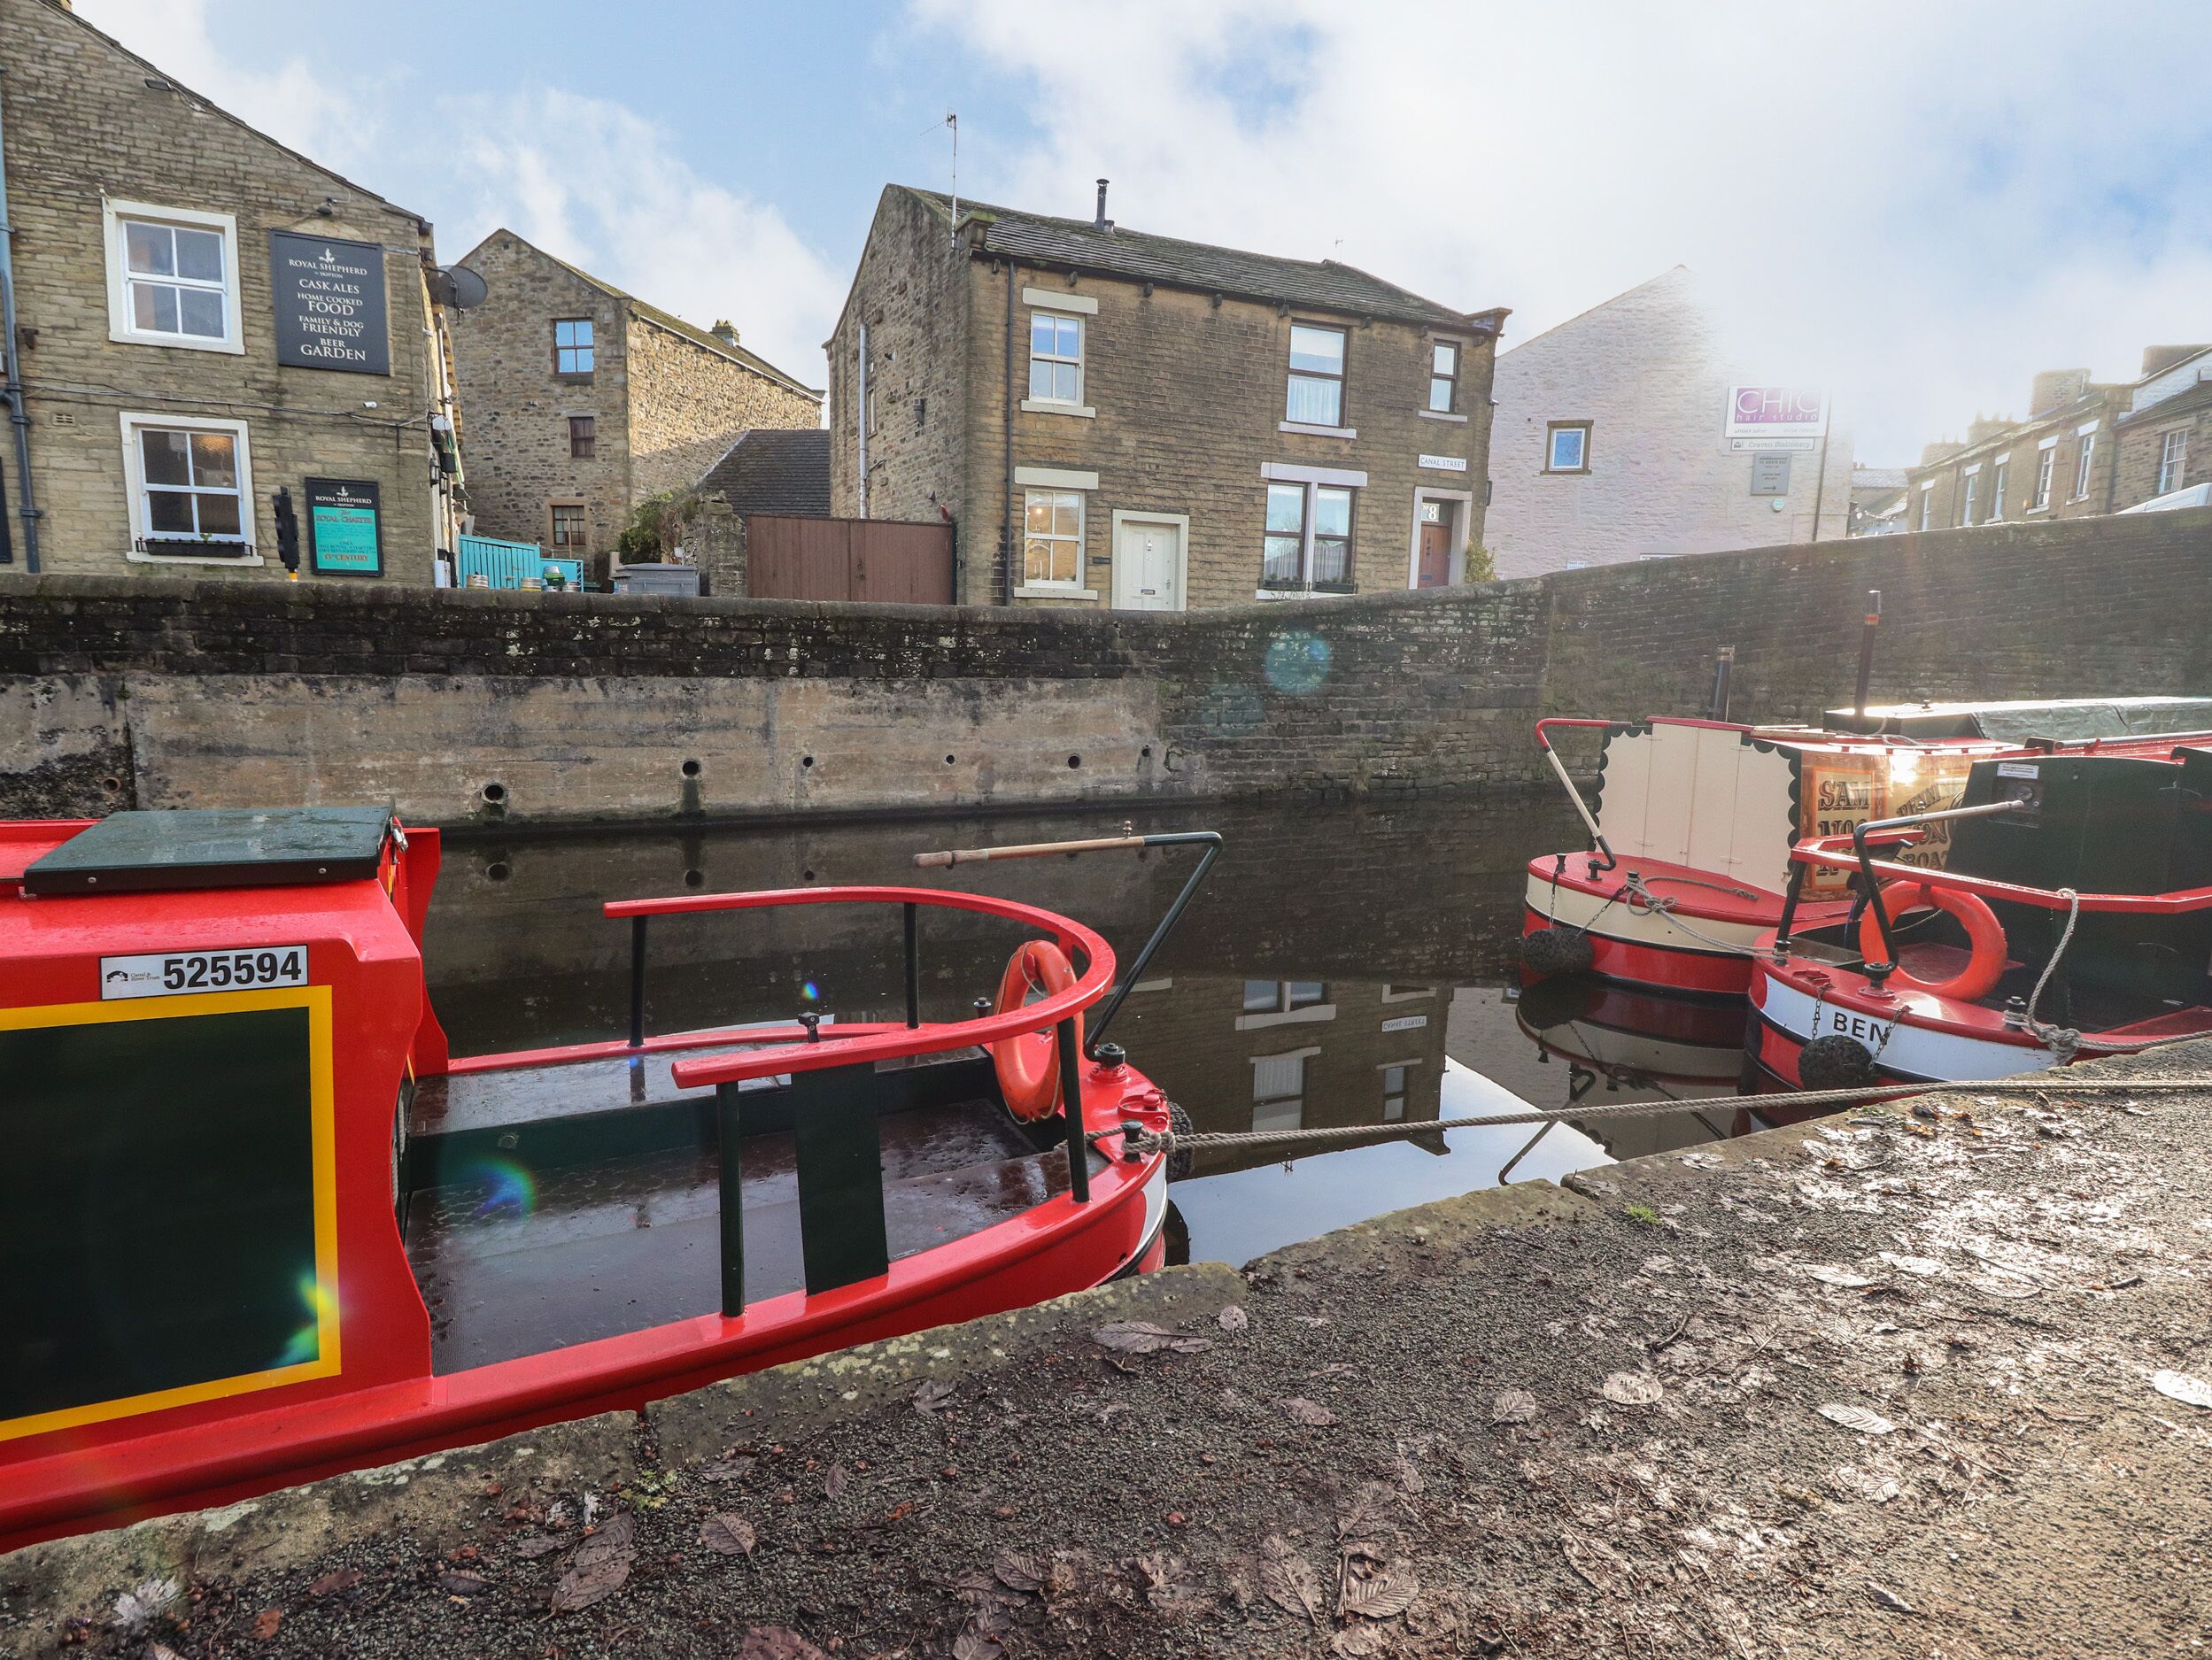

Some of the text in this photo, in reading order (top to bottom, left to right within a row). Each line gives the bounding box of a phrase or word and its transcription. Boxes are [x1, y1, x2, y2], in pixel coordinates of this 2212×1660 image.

[289, 259, 367, 276] ROYAL SHEPHERD
[299, 279, 360, 294] CASK ALES
[298, 292, 363, 306] HOME COOKED
[308, 300, 354, 316] FOOD
[298, 315, 331, 326] FAMILY
[344, 320, 364, 329] DOG
[302, 323, 361, 337] FRIENDLY
[320, 337, 345, 347] BEER
[300, 344, 366, 361] GARDEN
[1737, 390, 1819, 413] CHIC
[1773, 413, 1818, 421] studio
[1419, 457, 1465, 468] CANAL STREET
[1428, 506, 1437, 521] 8
[336, 553, 368, 562] CENTURY
[1818, 780, 1870, 811] SAM
[164, 951, 301, 990] 525594
[1833, 1012, 1888, 1045] BEN
